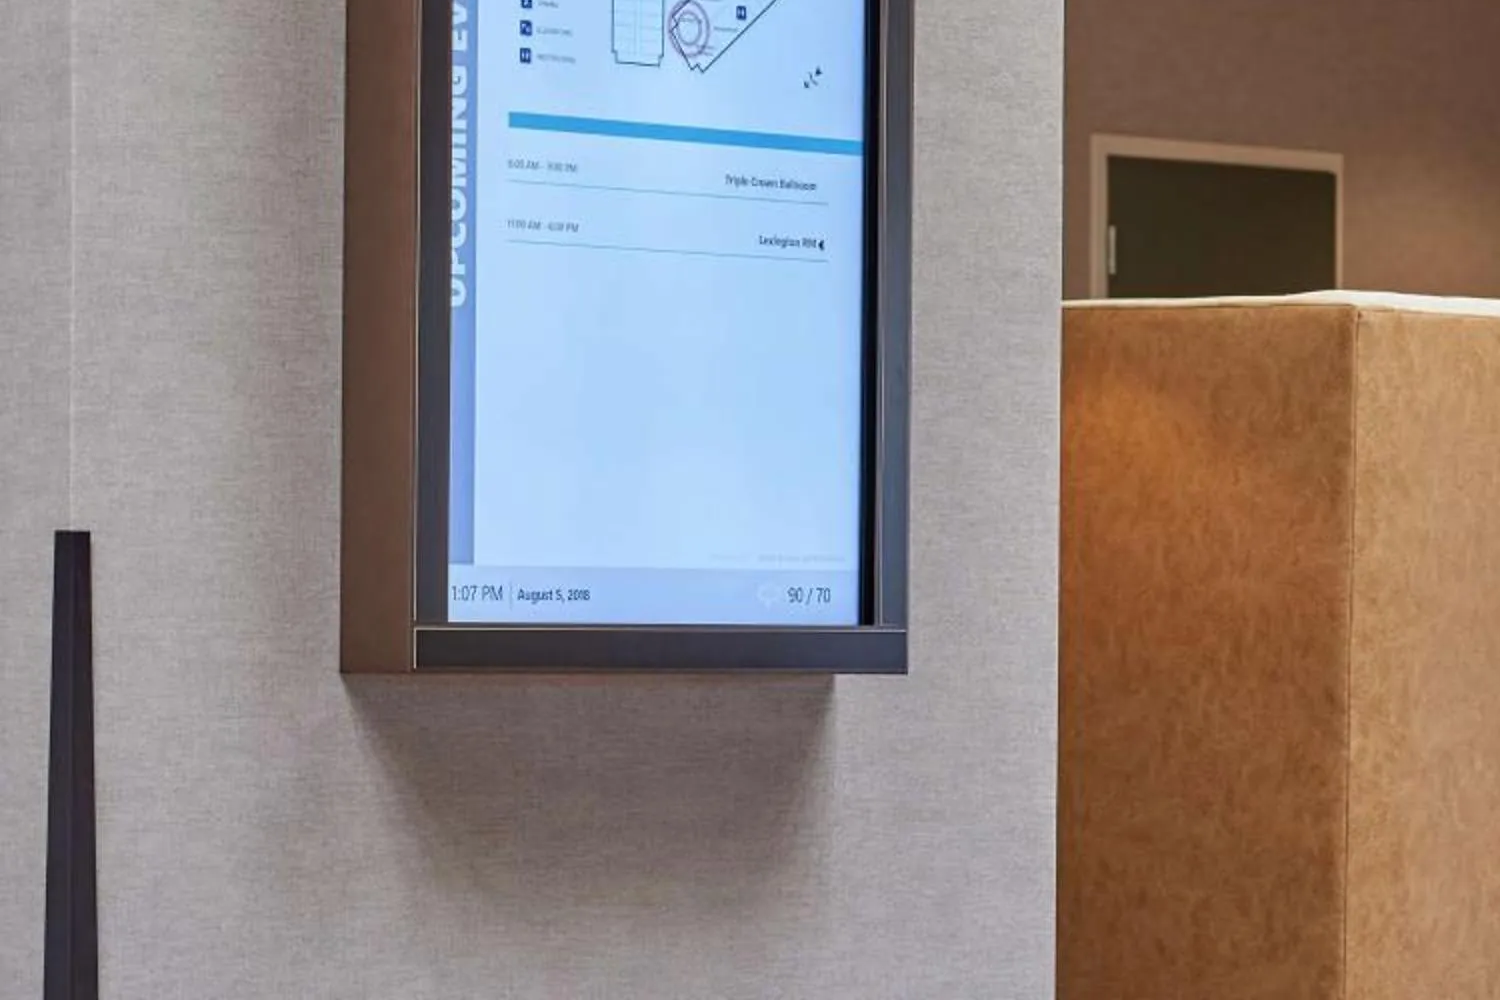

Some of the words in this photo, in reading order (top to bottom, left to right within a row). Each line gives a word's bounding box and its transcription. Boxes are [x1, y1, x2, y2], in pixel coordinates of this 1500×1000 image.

[450, 65, 468, 308] UPCOMING
[452, 585, 478, 601] 1:07
[481, 585, 504, 601] PM
[517, 587, 553, 605] August
[555, 588, 566, 604] 5,
[567, 588, 592, 601] 2018
[787, 586, 804, 604] 90
[816, 586, 832, 604] 70
